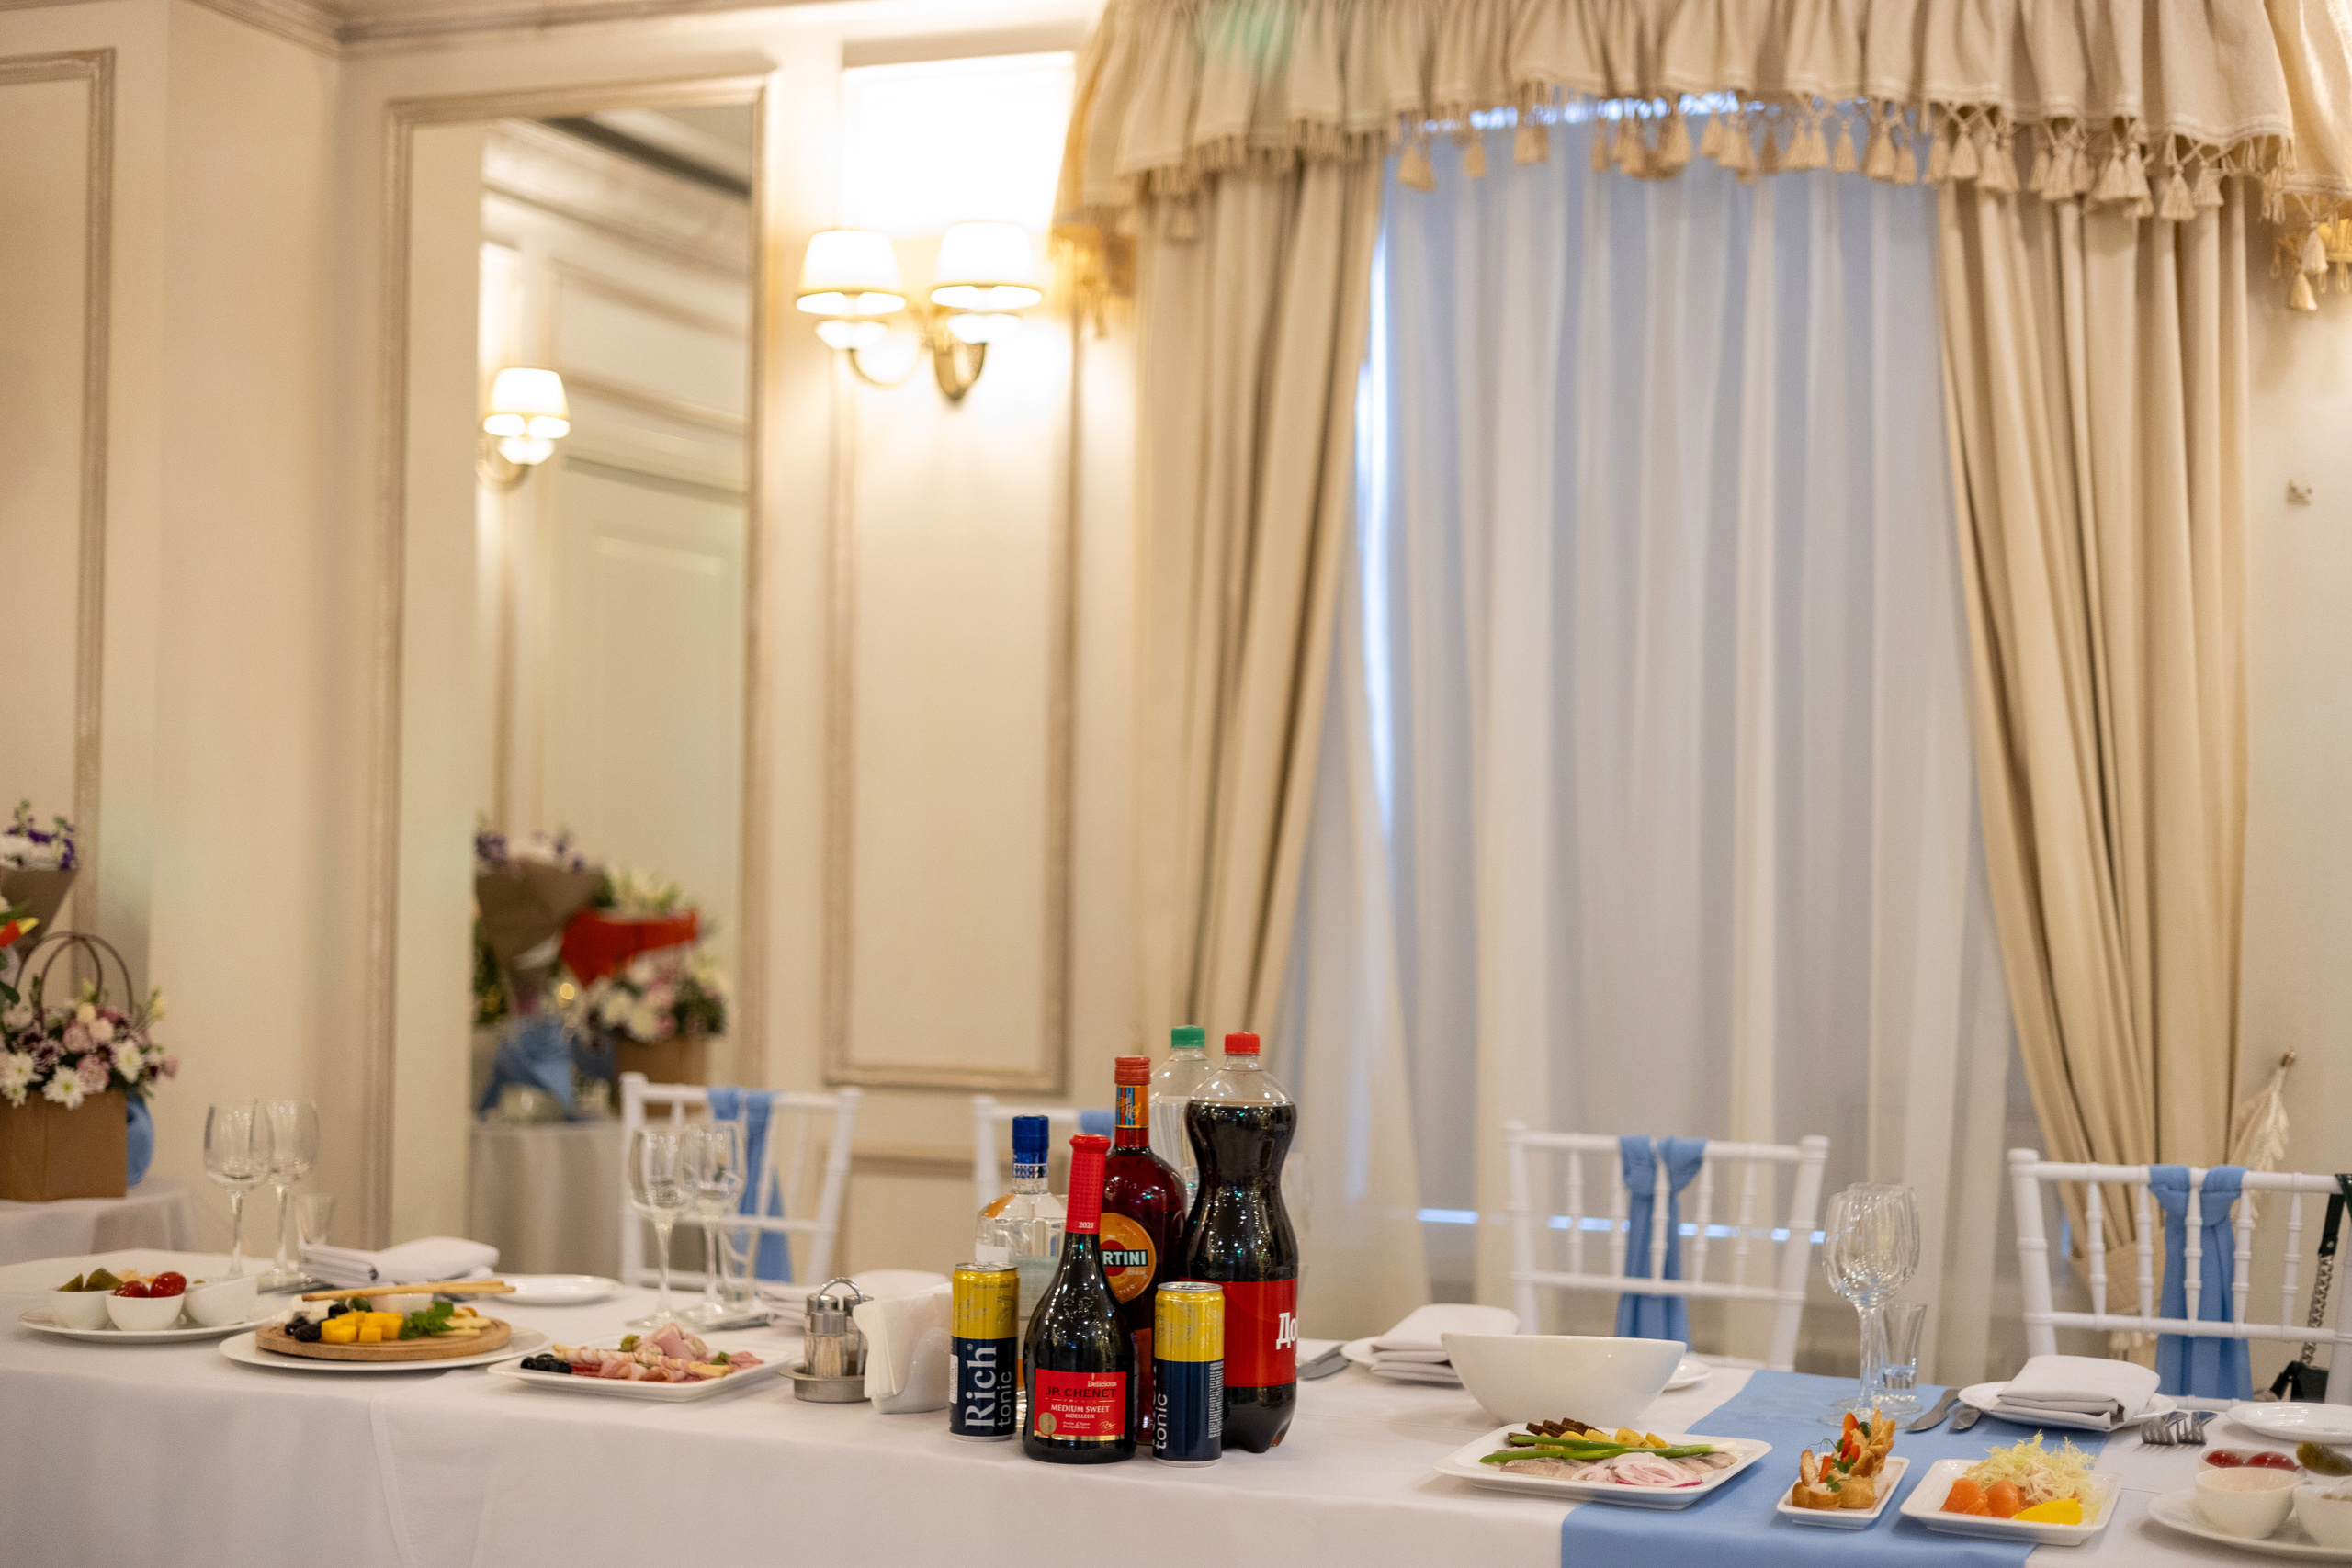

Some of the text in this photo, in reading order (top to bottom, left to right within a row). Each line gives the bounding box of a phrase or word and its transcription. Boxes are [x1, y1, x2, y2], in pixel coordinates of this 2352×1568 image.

[1078, 1221, 1094, 1229] 2021
[1102, 1251, 1147, 1265] RTINI
[1275, 1312, 1297, 1350] До
[965, 1346, 997, 1427] Rich
[1087, 1380, 1117, 1388] Delicious
[997, 1371, 1012, 1427] tonic
[1046, 1386, 1117, 1398] JP. CHENET
[1050, 1404, 1084, 1413] MEDIUM
[1155, 1393, 1168, 1450] tonic
